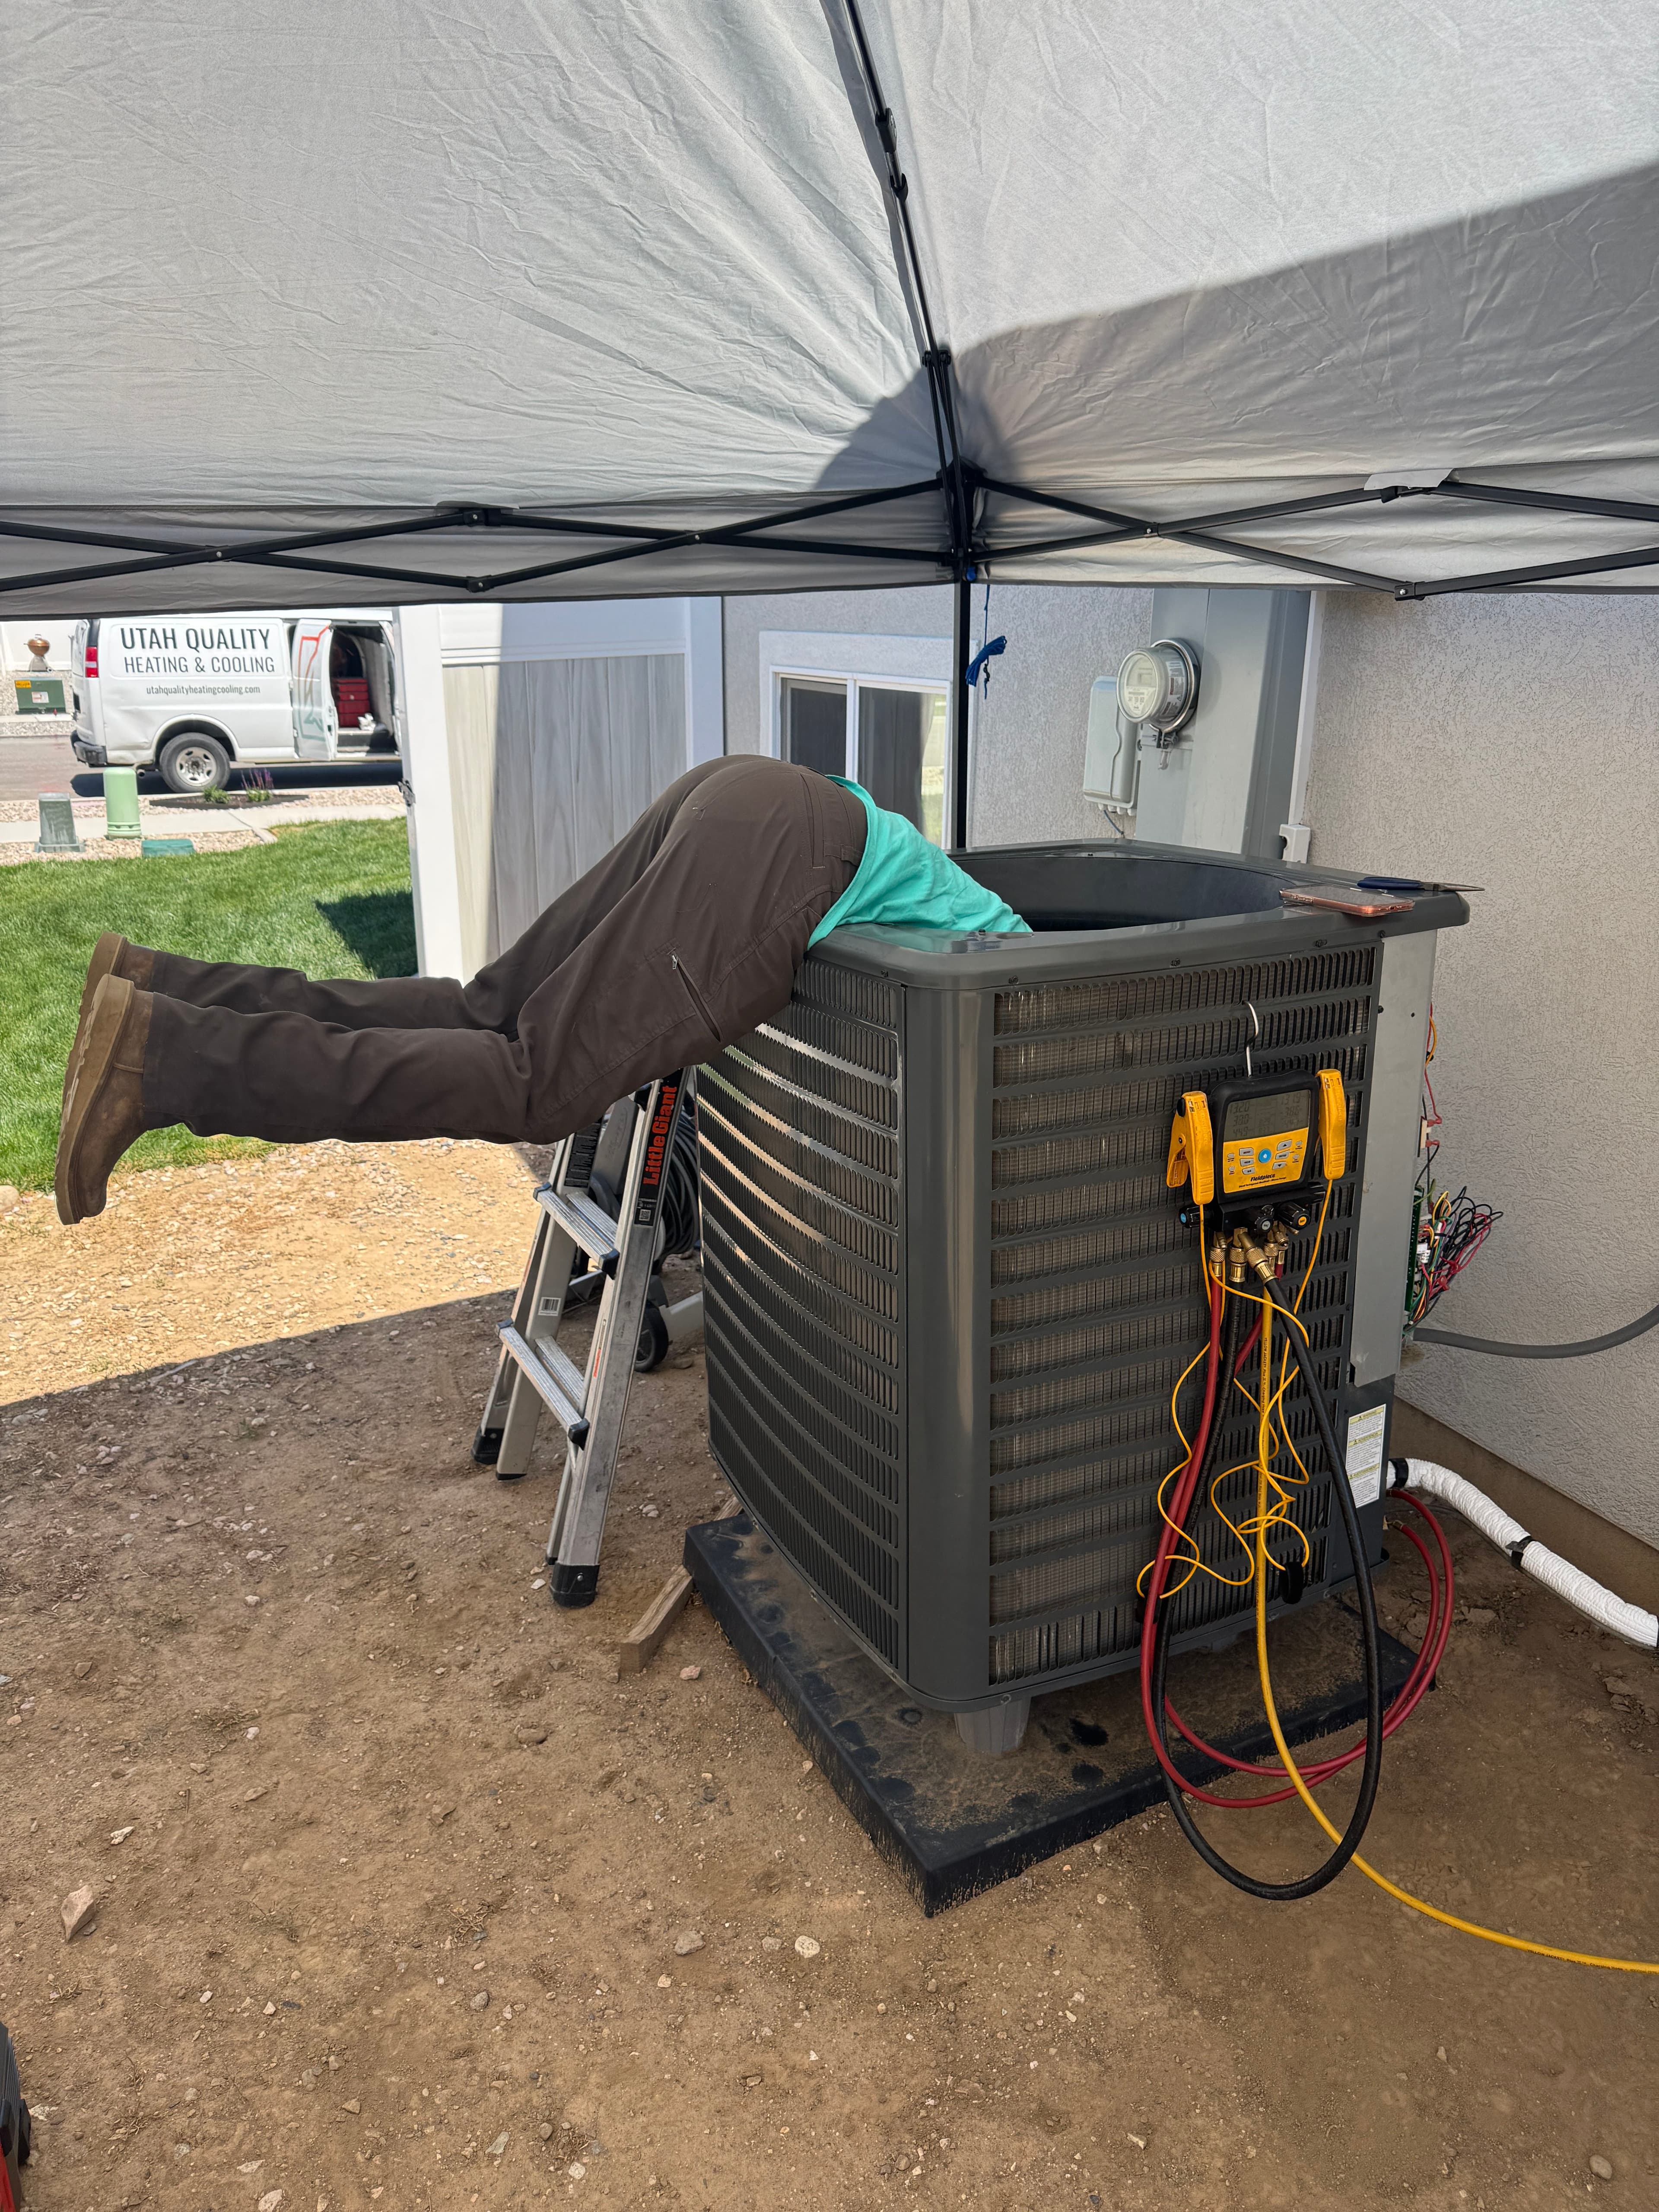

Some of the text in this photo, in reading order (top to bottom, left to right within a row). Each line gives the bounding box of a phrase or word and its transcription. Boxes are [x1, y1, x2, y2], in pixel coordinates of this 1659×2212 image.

[121, 628, 270, 653] UTAH QUALITY
[124, 657, 275, 673] HEATING & COOLING
[146, 684, 261, 696] utahqualityheatingcooling.com
[652, 1085, 677, 1134] Giant
[643, 1135, 666, 1185] Little
